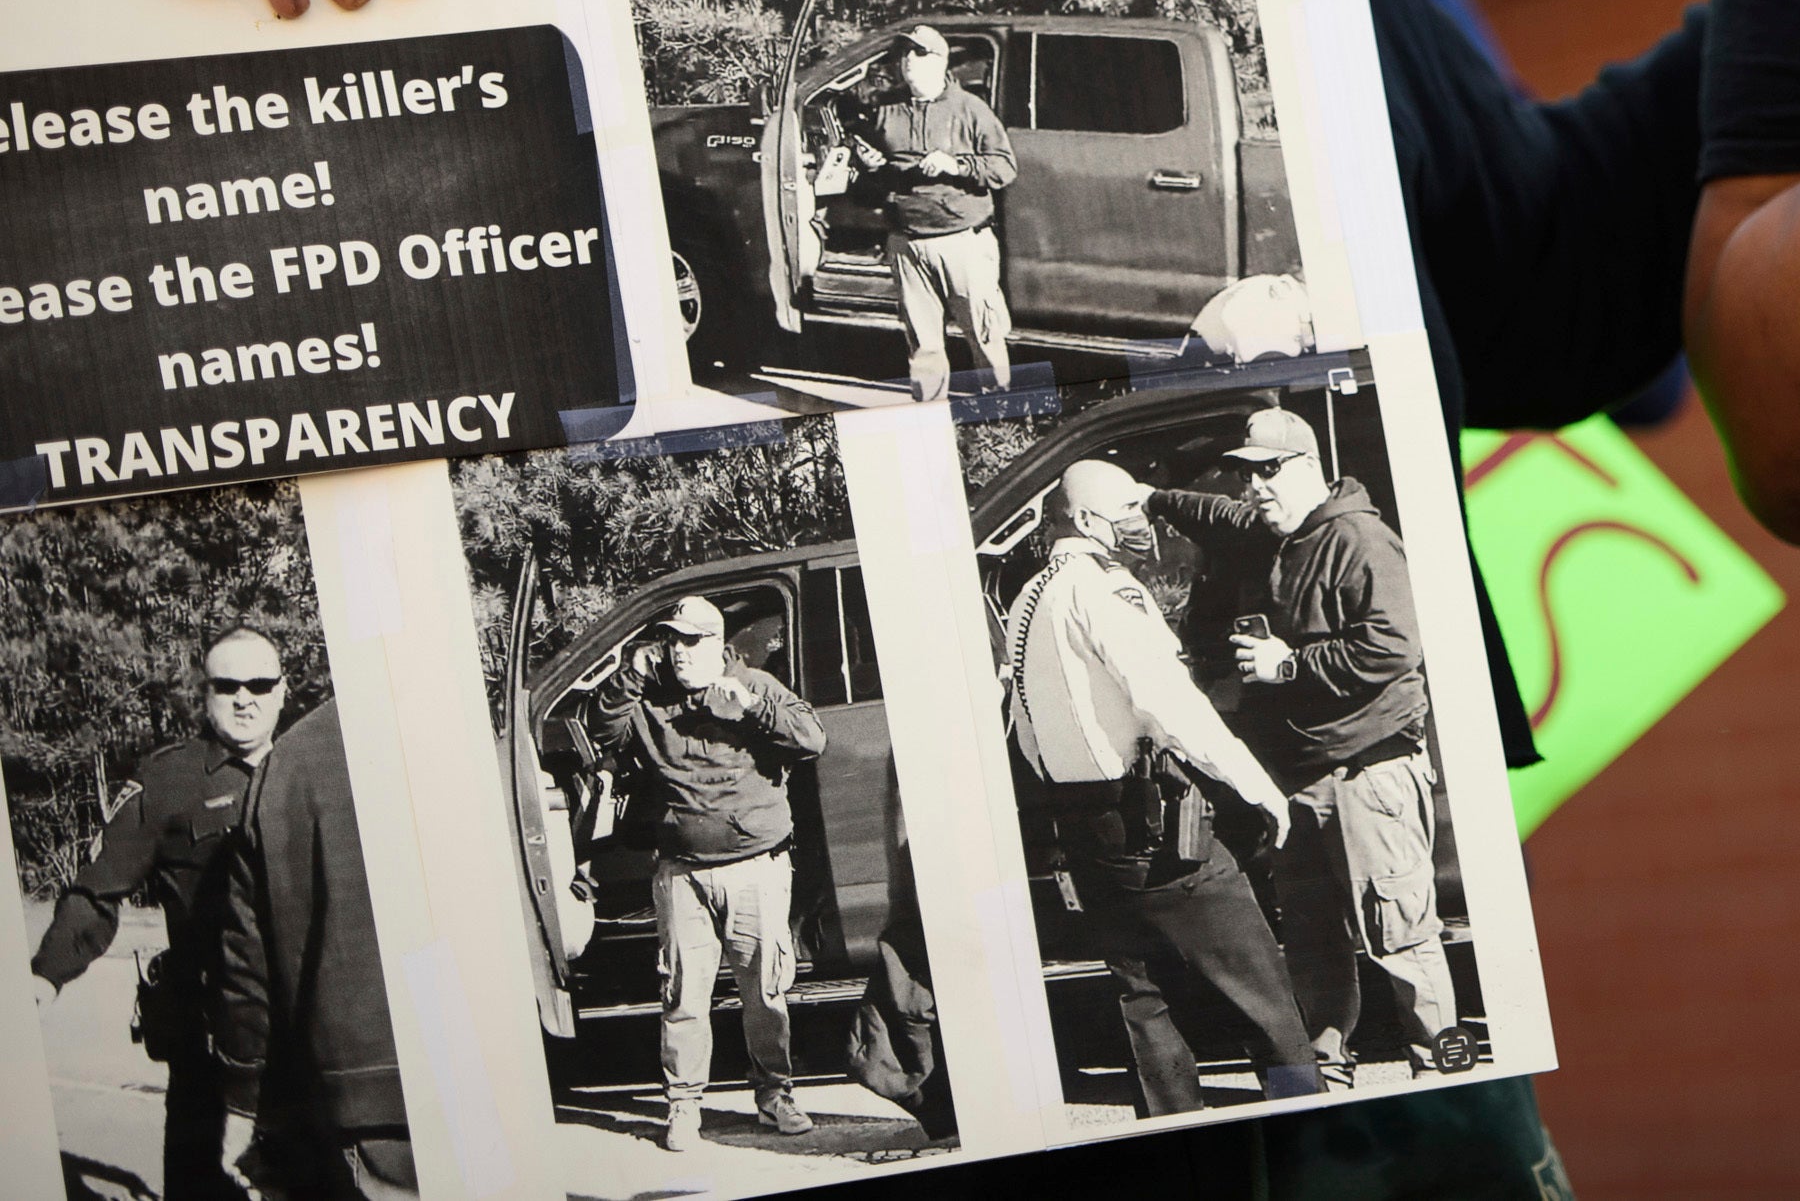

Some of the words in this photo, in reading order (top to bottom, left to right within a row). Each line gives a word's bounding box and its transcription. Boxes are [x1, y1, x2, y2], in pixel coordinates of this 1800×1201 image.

[0, 101, 171, 153] lease
[186, 84, 291, 136] the
[303, 64, 509, 125] killer's
[143, 159, 336, 224] name!
[148, 255, 254, 307] the
[269, 240, 381, 294] FPD
[398, 224, 599, 281] Officer
[158, 321, 382, 390] names!
[34, 391, 516, 488] TRANSPARENCY
